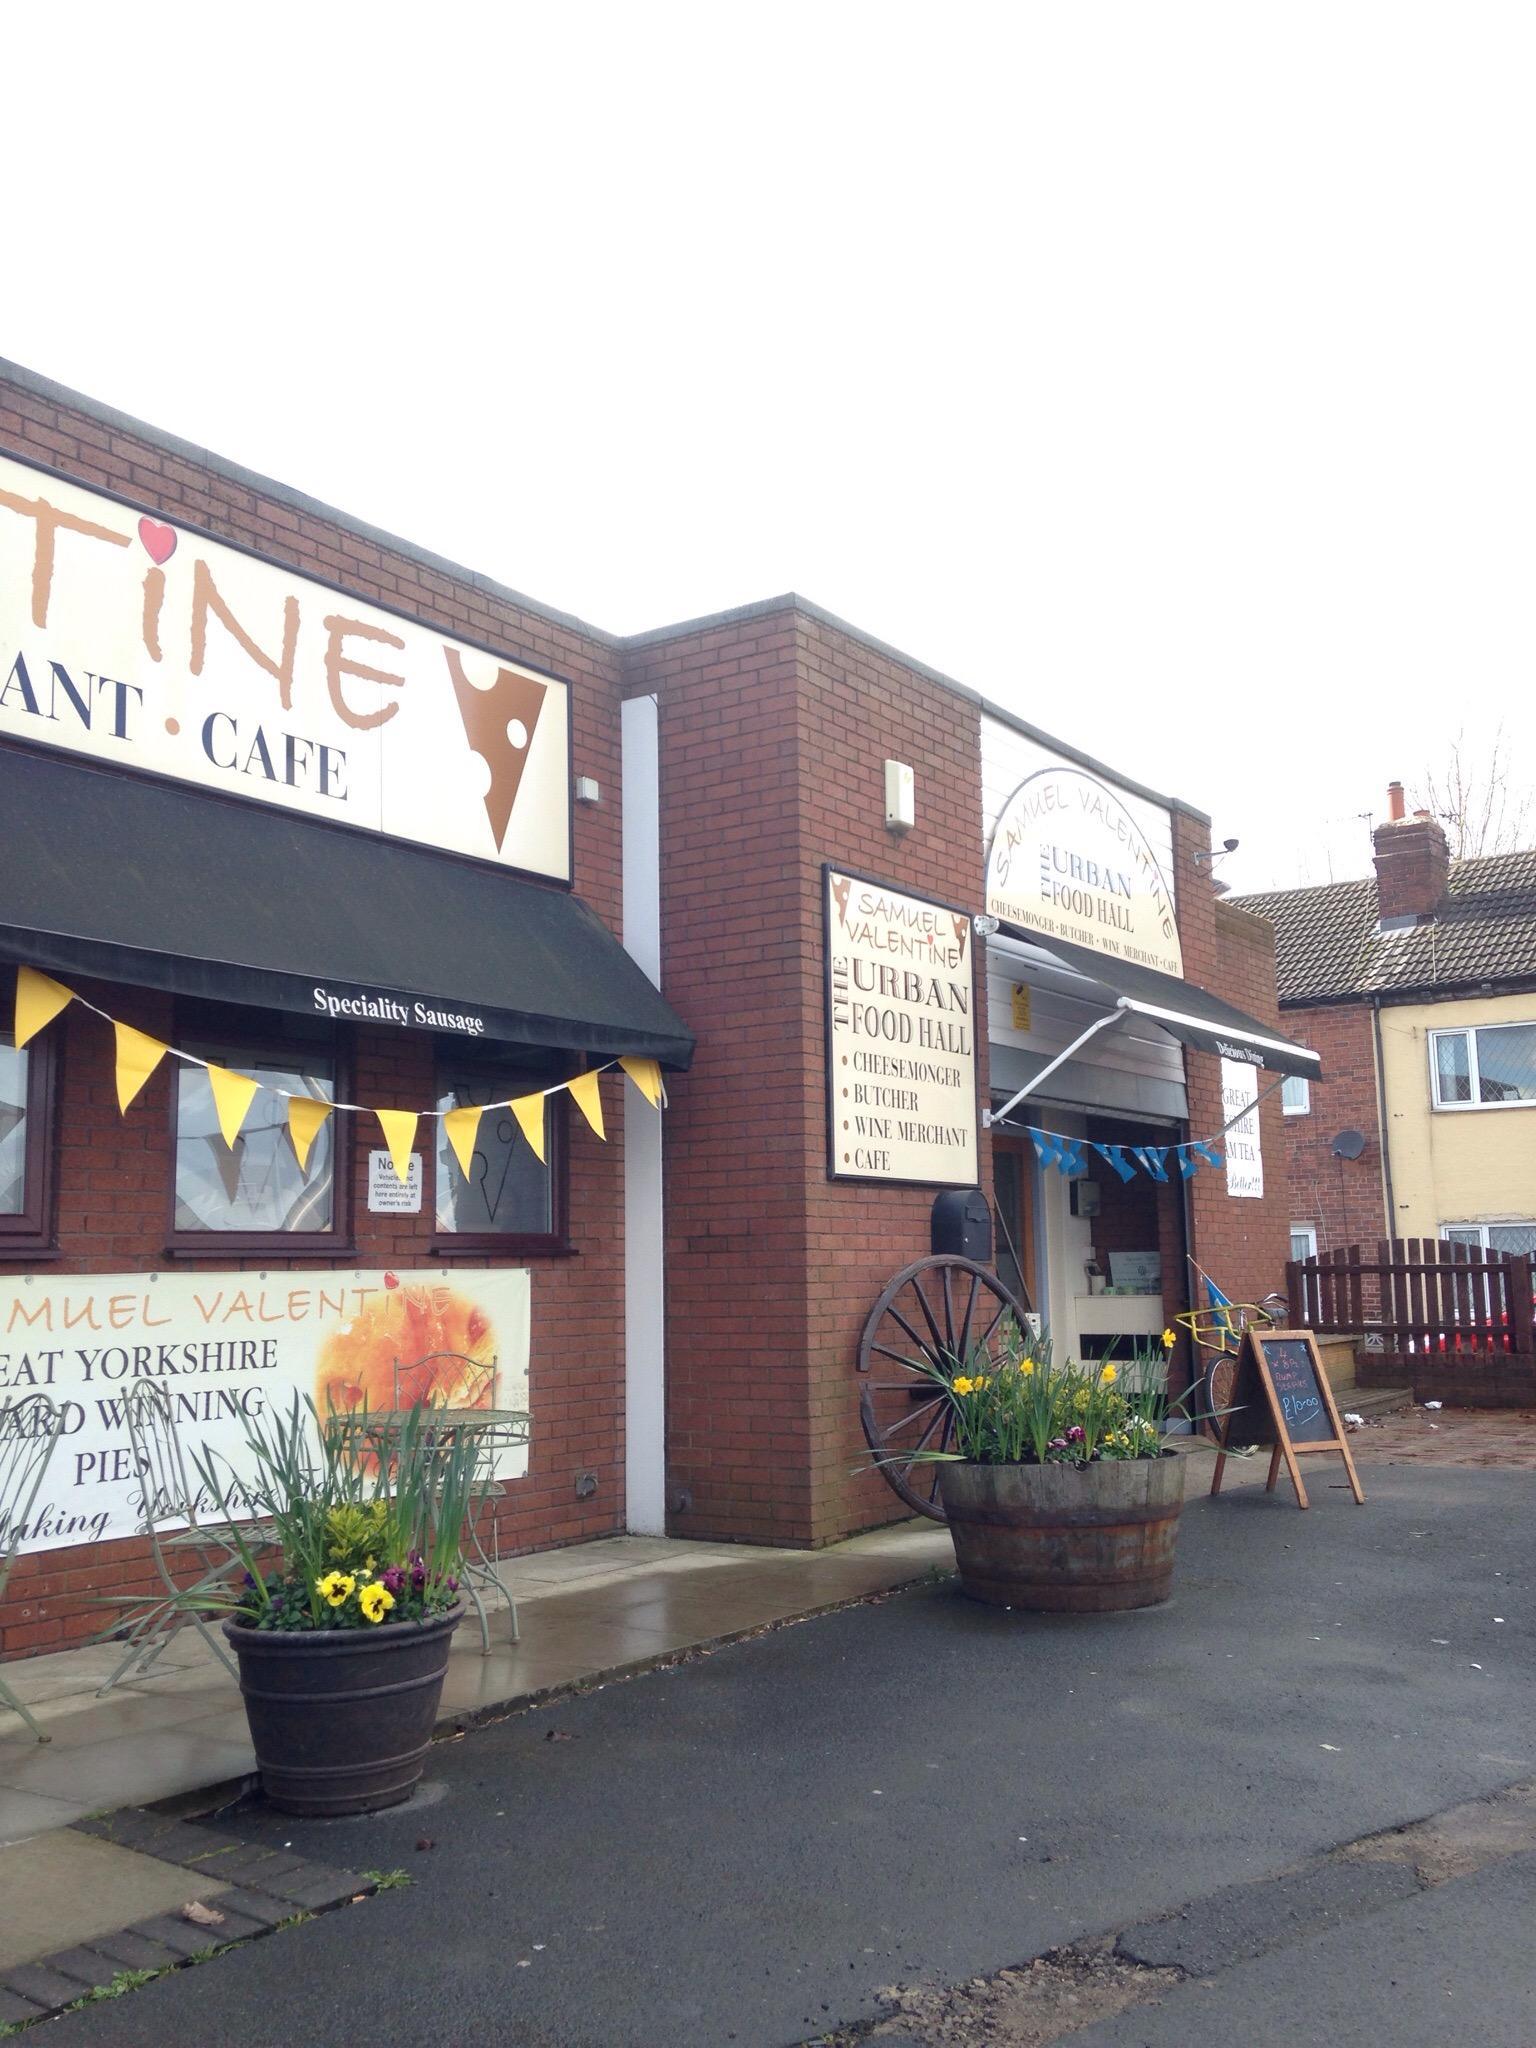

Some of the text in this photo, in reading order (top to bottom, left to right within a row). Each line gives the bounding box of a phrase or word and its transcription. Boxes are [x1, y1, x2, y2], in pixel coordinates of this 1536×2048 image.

[201, 711, 348, 801] CAFE
[996, 783, 1069, 888] SAMUEL
[1052, 846, 1131, 900] URBAN
[858, 893, 946, 937] SAMUEL
[1052, 881, 1134, 933] FOOD HALL
[991, 898, 1054, 932] CHEESEMONGER
[1060, 922, 1094, 946] BUTCHER
[1102, 937, 1121, 955] WINE
[1163, 959, 1178, 974] CAFE
[833, 956, 848, 1031] THE
[851, 957, 968, 1015] URBAN
[313, 987, 485, 1036] Speciality Sausage
[852, 1001, 913, 1044] FOOD
[919, 1016, 971, 1056] HALL
[853, 1050, 961, 1089] CHEESEMONGER
[854, 1083, 919, 1112] BUTCHER
[854, 1115, 968, 1148] WINE MERCHANT
[1238, 1142, 1255, 1161] TEA
[378, 1157, 415, 1171] Noe
[854, 1148, 890, 1171] CAFE
[75, 1339, 278, 1382] YORKSHIRE
[73, 1446, 150, 1486] PIES
